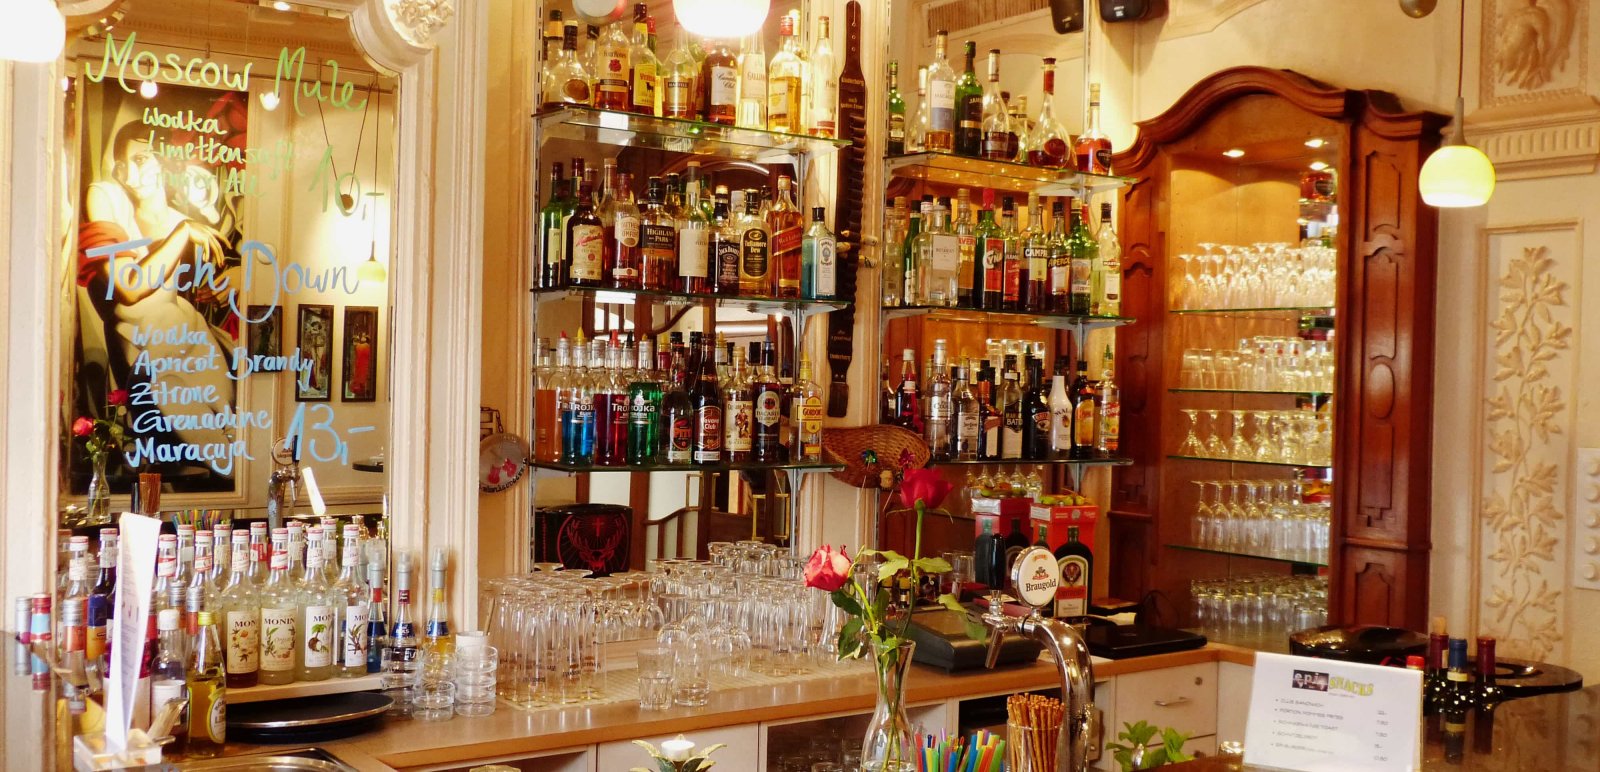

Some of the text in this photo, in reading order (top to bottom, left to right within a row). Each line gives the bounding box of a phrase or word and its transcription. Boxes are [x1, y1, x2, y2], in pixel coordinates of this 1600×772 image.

[85, 31, 368, 117] Moscow Mule
[142, 107, 228, 135] Wodka
[85, 238, 360, 324] Touch Down
[131, 322, 215, 347] Wodka
[133, 345, 314, 392] Apricot Brandy
[128, 381, 222, 406] Zitrone
[132, 405, 273, 434] Grenadine
[124, 433, 255, 475] Maracuja
[1025, 578, 1057, 592] Braugold
